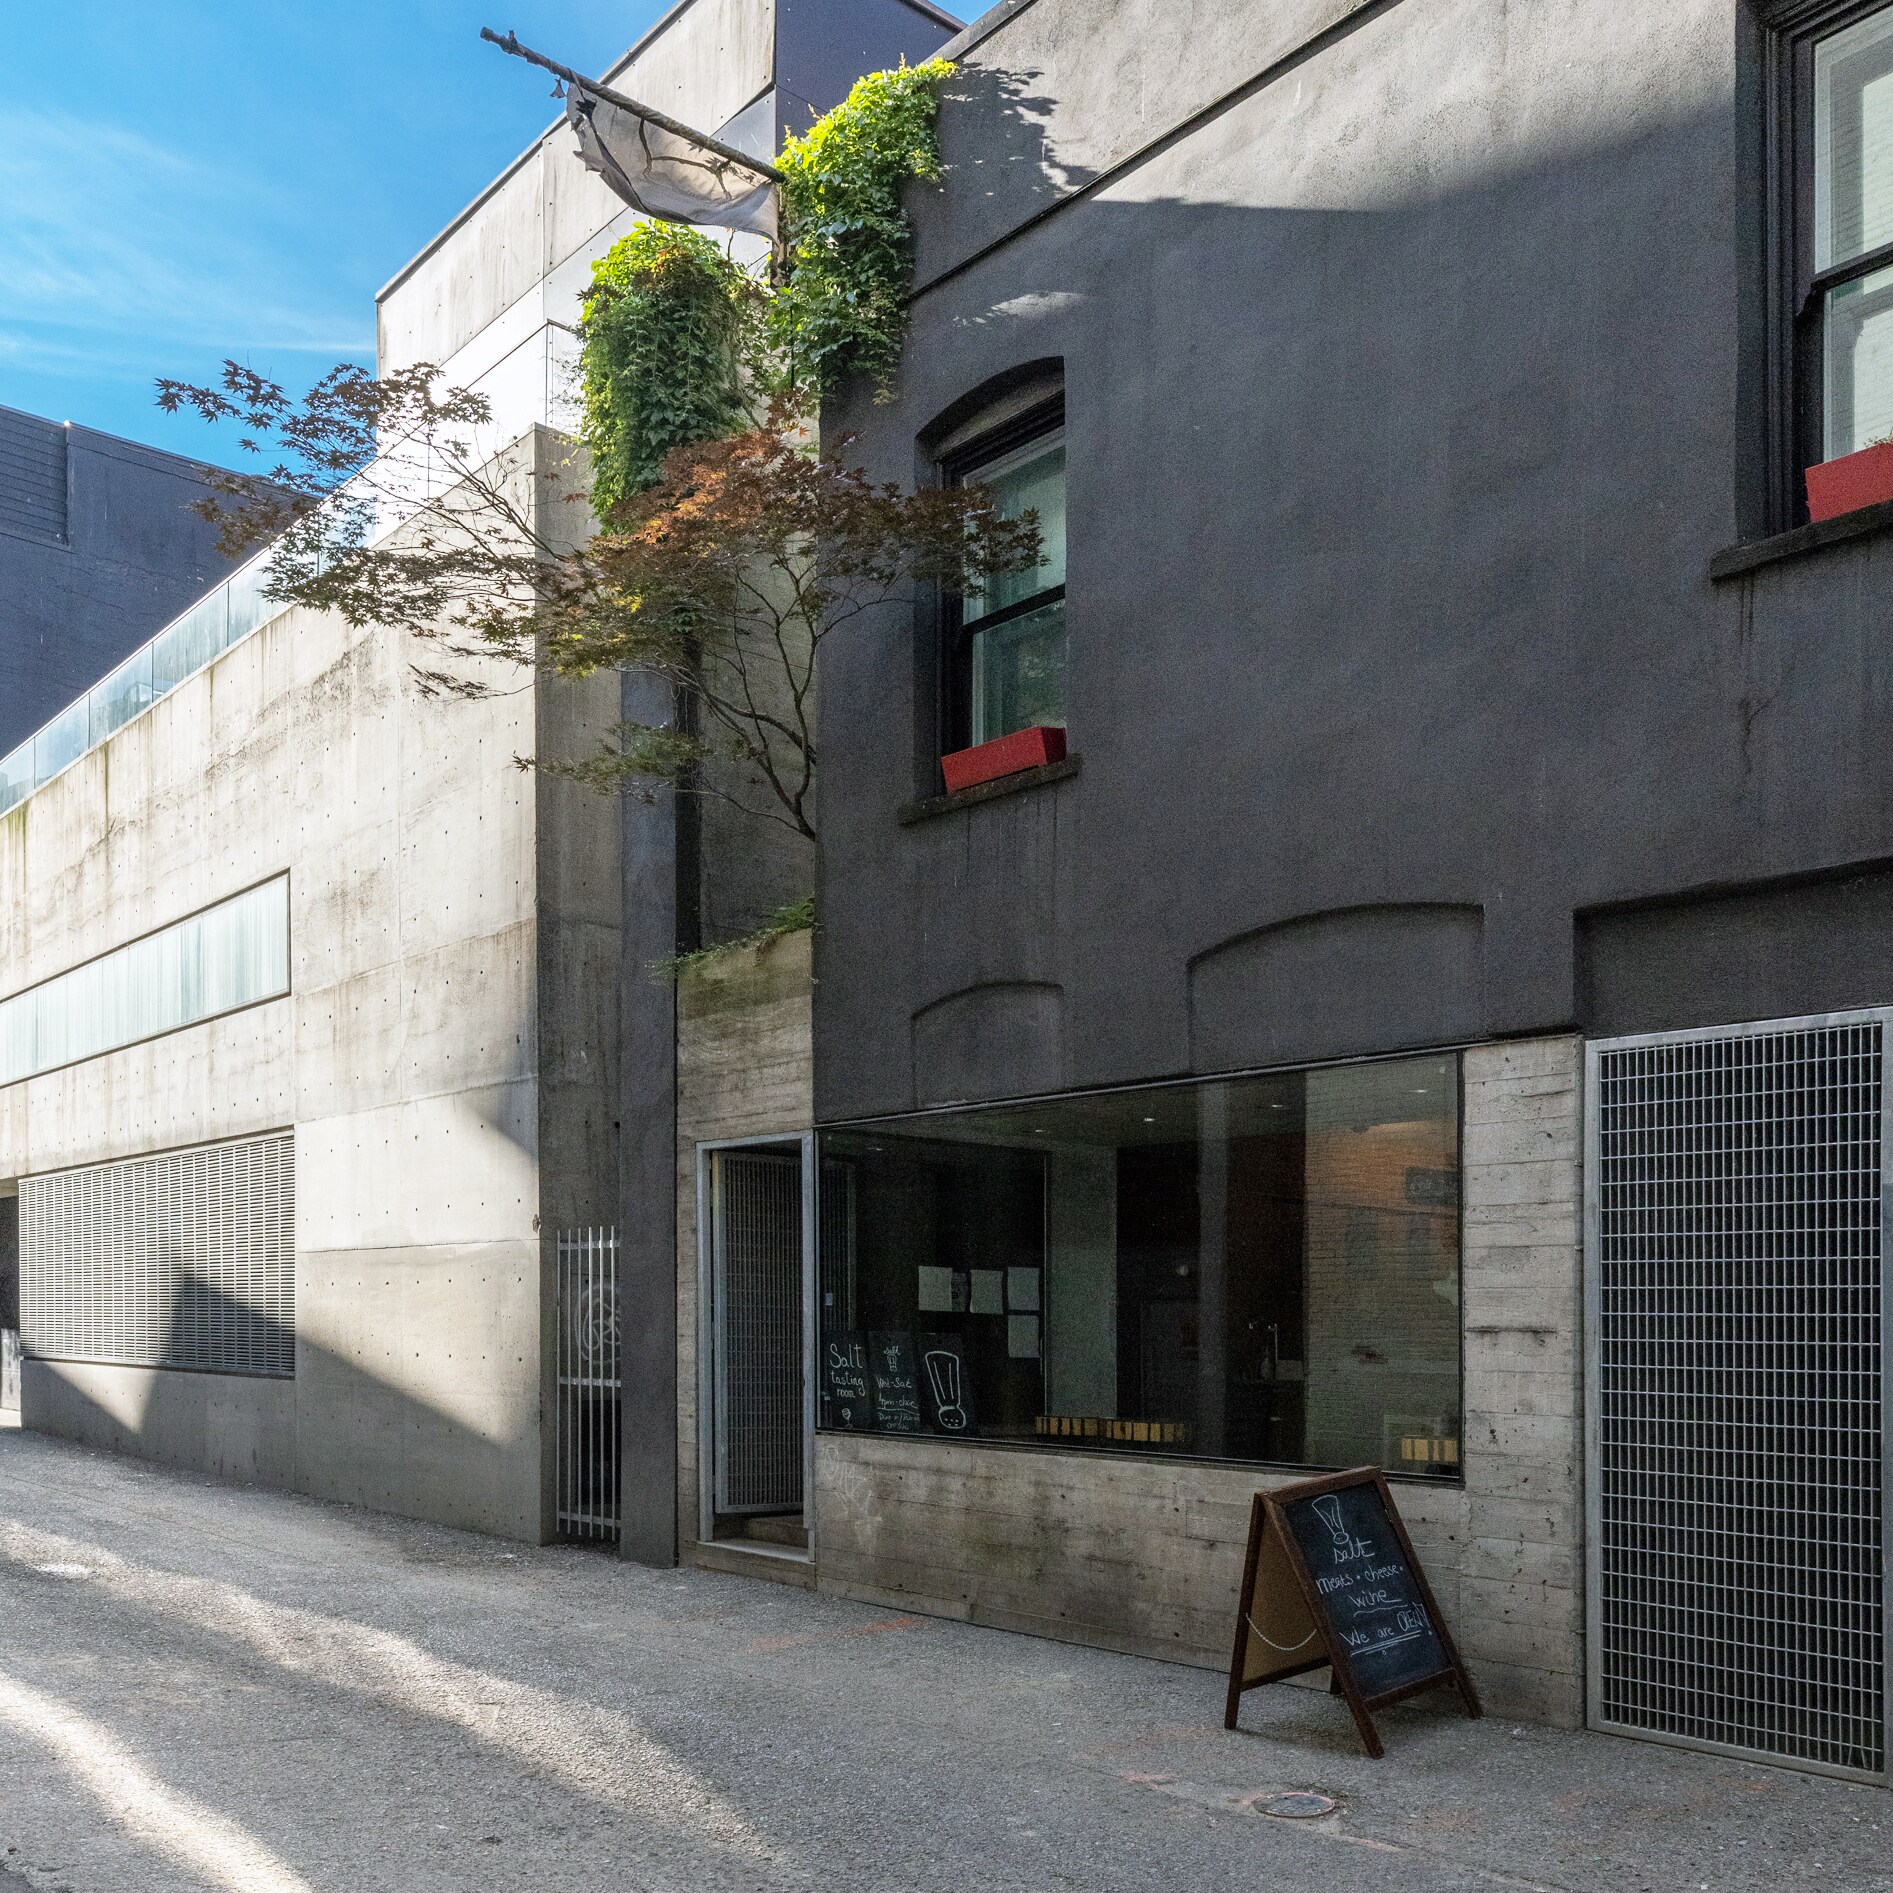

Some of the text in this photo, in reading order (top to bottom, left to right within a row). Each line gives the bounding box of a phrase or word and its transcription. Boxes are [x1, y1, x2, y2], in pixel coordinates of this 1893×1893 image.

[830, 1343, 863, 1368] Salt
[830, 1370, 866, 1396] tasting
[837, 1388, 856, 1398] room
[1333, 1537, 1375, 1564] salt
[1350, 1589, 1402, 1607] wine
[1340, 1626, 1370, 1646] We
[1378, 1627, 1395, 1638] are
